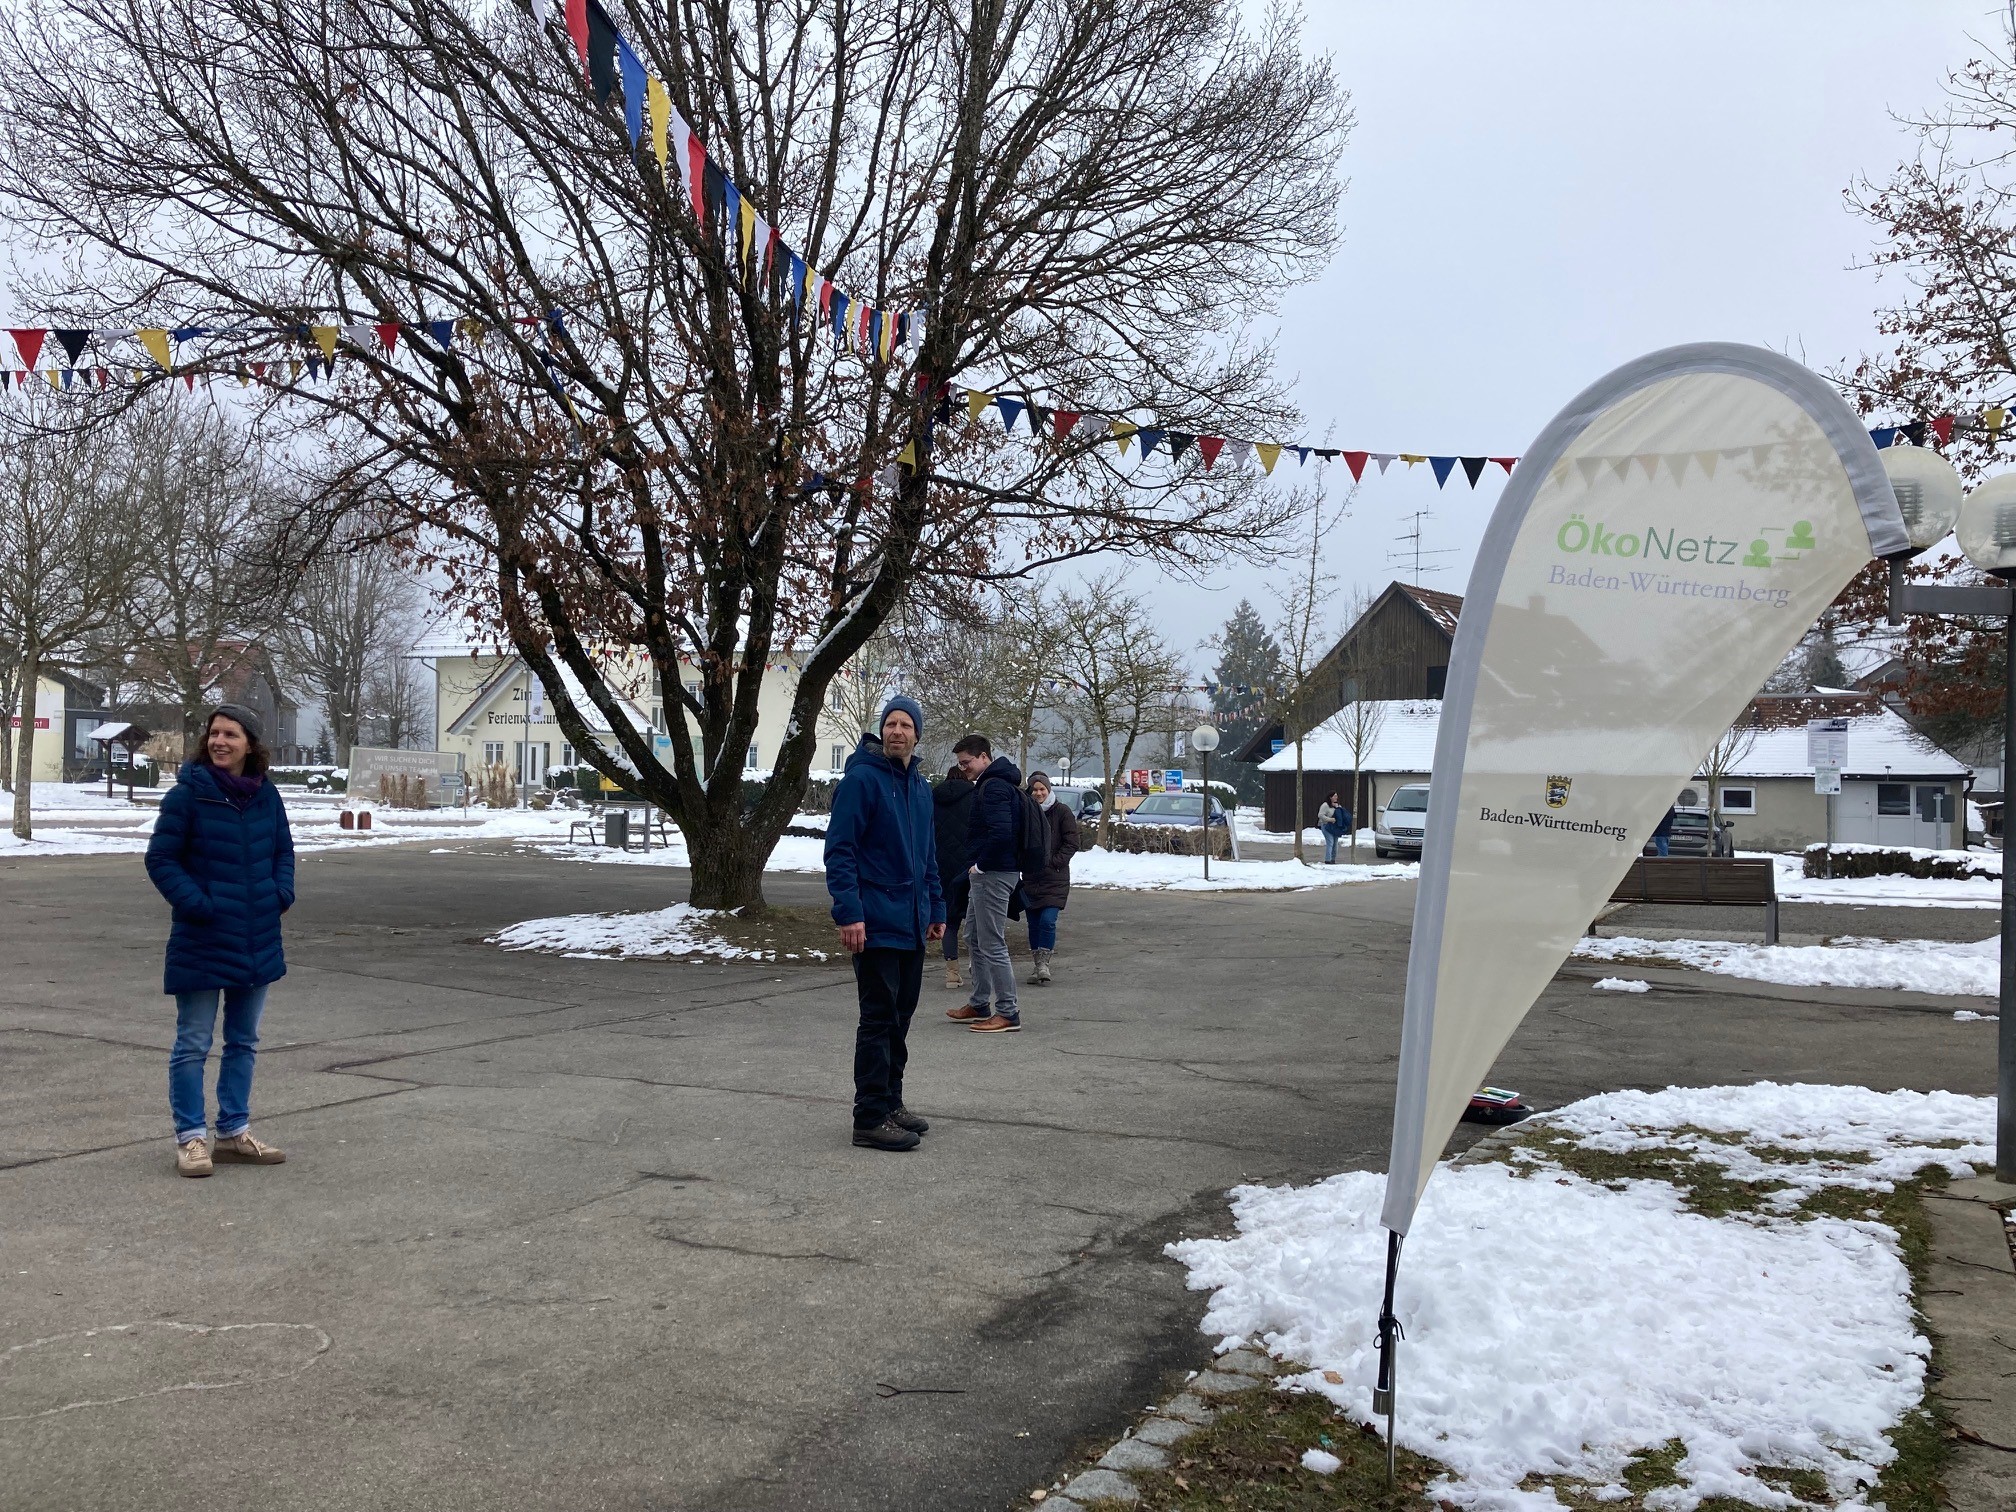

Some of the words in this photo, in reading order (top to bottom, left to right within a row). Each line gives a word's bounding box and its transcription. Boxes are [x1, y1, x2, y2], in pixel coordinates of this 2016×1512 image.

[1557, 513, 1739, 566] ÖkoNetz
[1547, 564, 1792, 609] Baden-Württemberg
[1479, 807, 1628, 842] Baden-Württemberg
